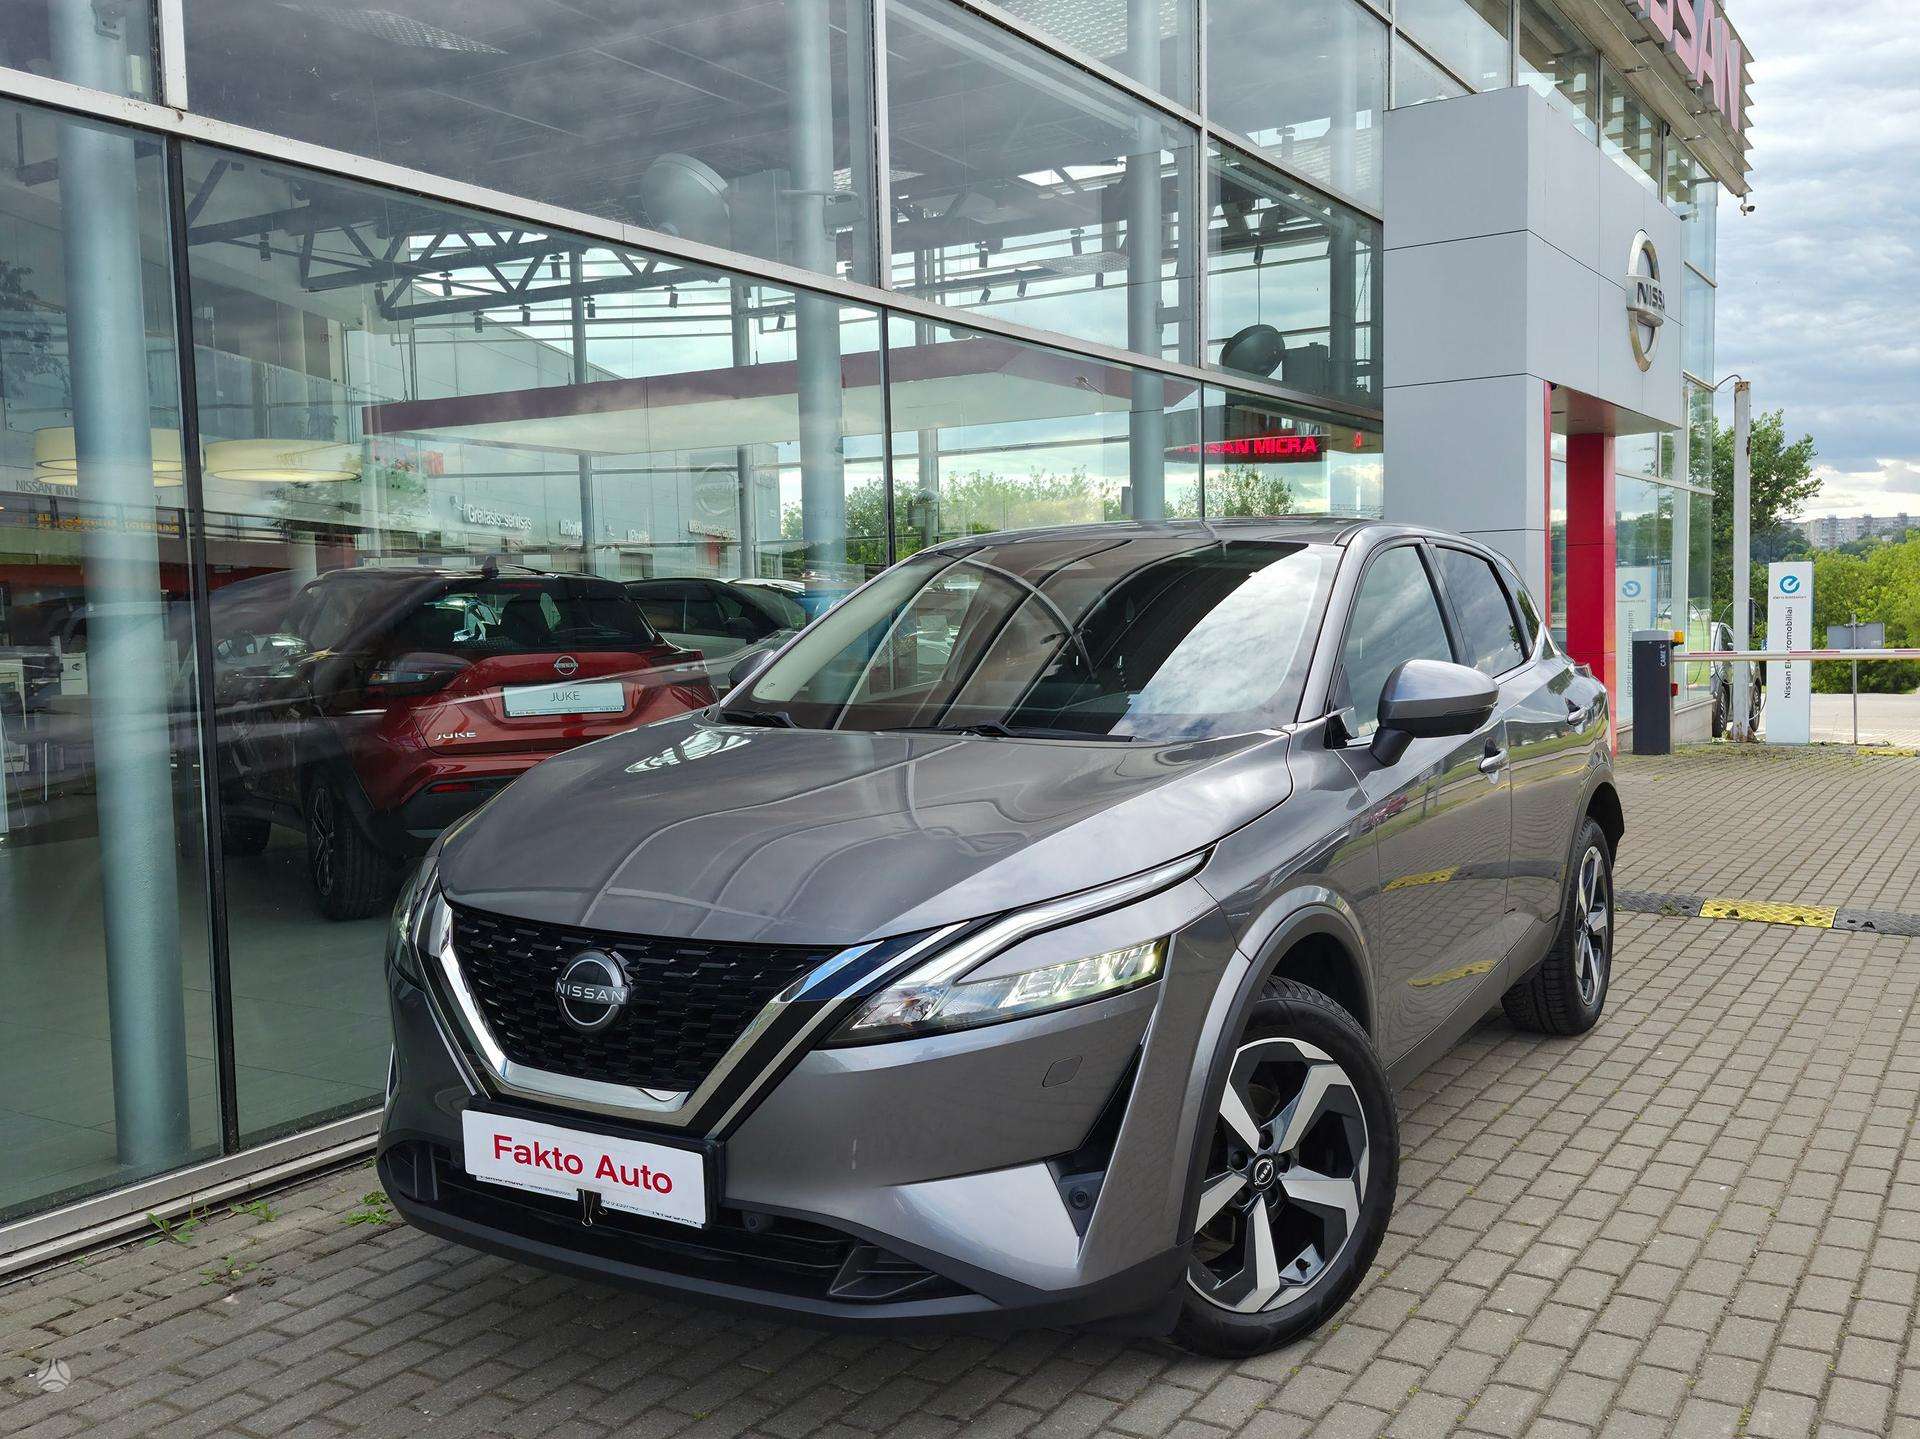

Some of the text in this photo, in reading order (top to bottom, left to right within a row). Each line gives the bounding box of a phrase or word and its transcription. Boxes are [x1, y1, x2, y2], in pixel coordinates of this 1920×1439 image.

[1638, 0, 1741, 133] SAN
[1254, 437, 1317, 454] MICRA
[550, 690, 581, 702] JUKE
[434, 732, 477, 741] JUKE
[556, 981, 625, 1002] NISSAN
[493, 1134, 584, 1175] Fakto
[595, 1154, 673, 1195] Auto
